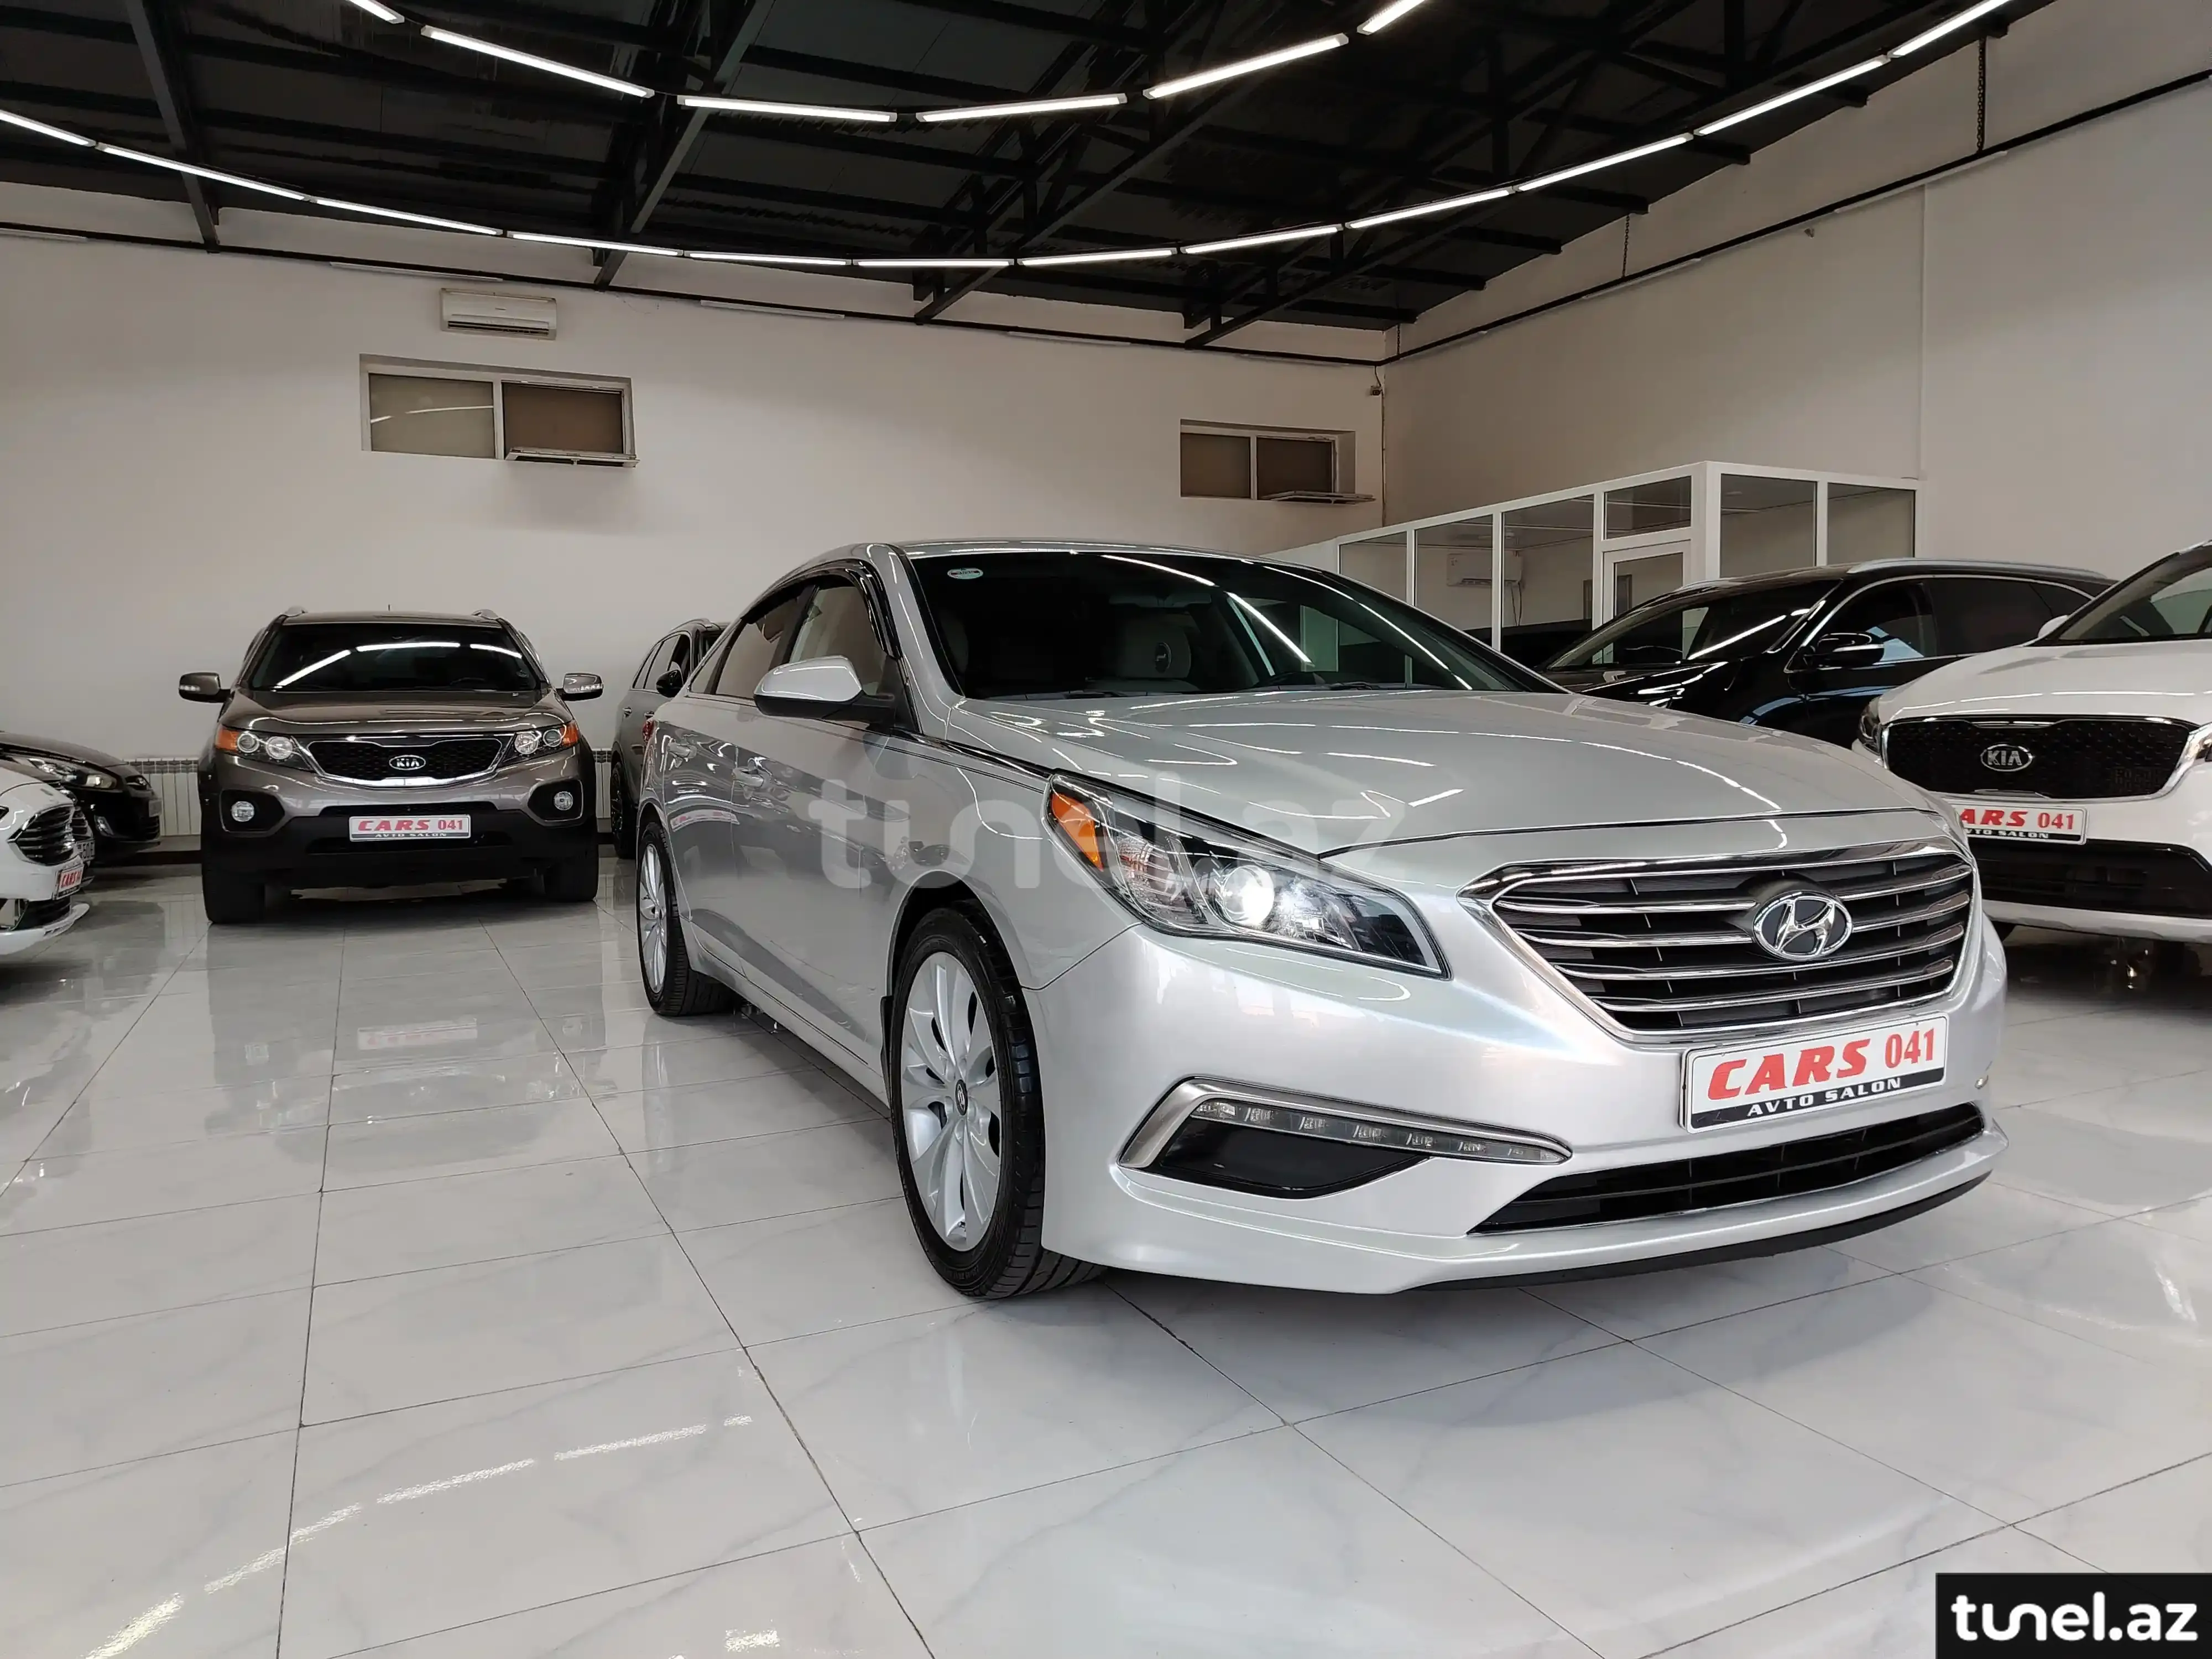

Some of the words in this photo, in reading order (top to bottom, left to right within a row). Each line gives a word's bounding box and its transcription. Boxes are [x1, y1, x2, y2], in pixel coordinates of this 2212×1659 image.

[395, 758, 420, 768] KIA
[1986, 750, 2024, 766] KIA
[358, 820, 431, 831] CARS
[437, 820, 463, 830] 041
[1959, 808, 2028, 827] ARS
[2038, 812, 2074, 830] 041
[1998, 830, 2049, 839] SALON
[1707, 1038, 1871, 1100] CARS
[1884, 1027, 1935, 1070] 041
[1747, 1094, 1814, 1117] AVTO
[1824, 1077, 1902, 1102] SALON
